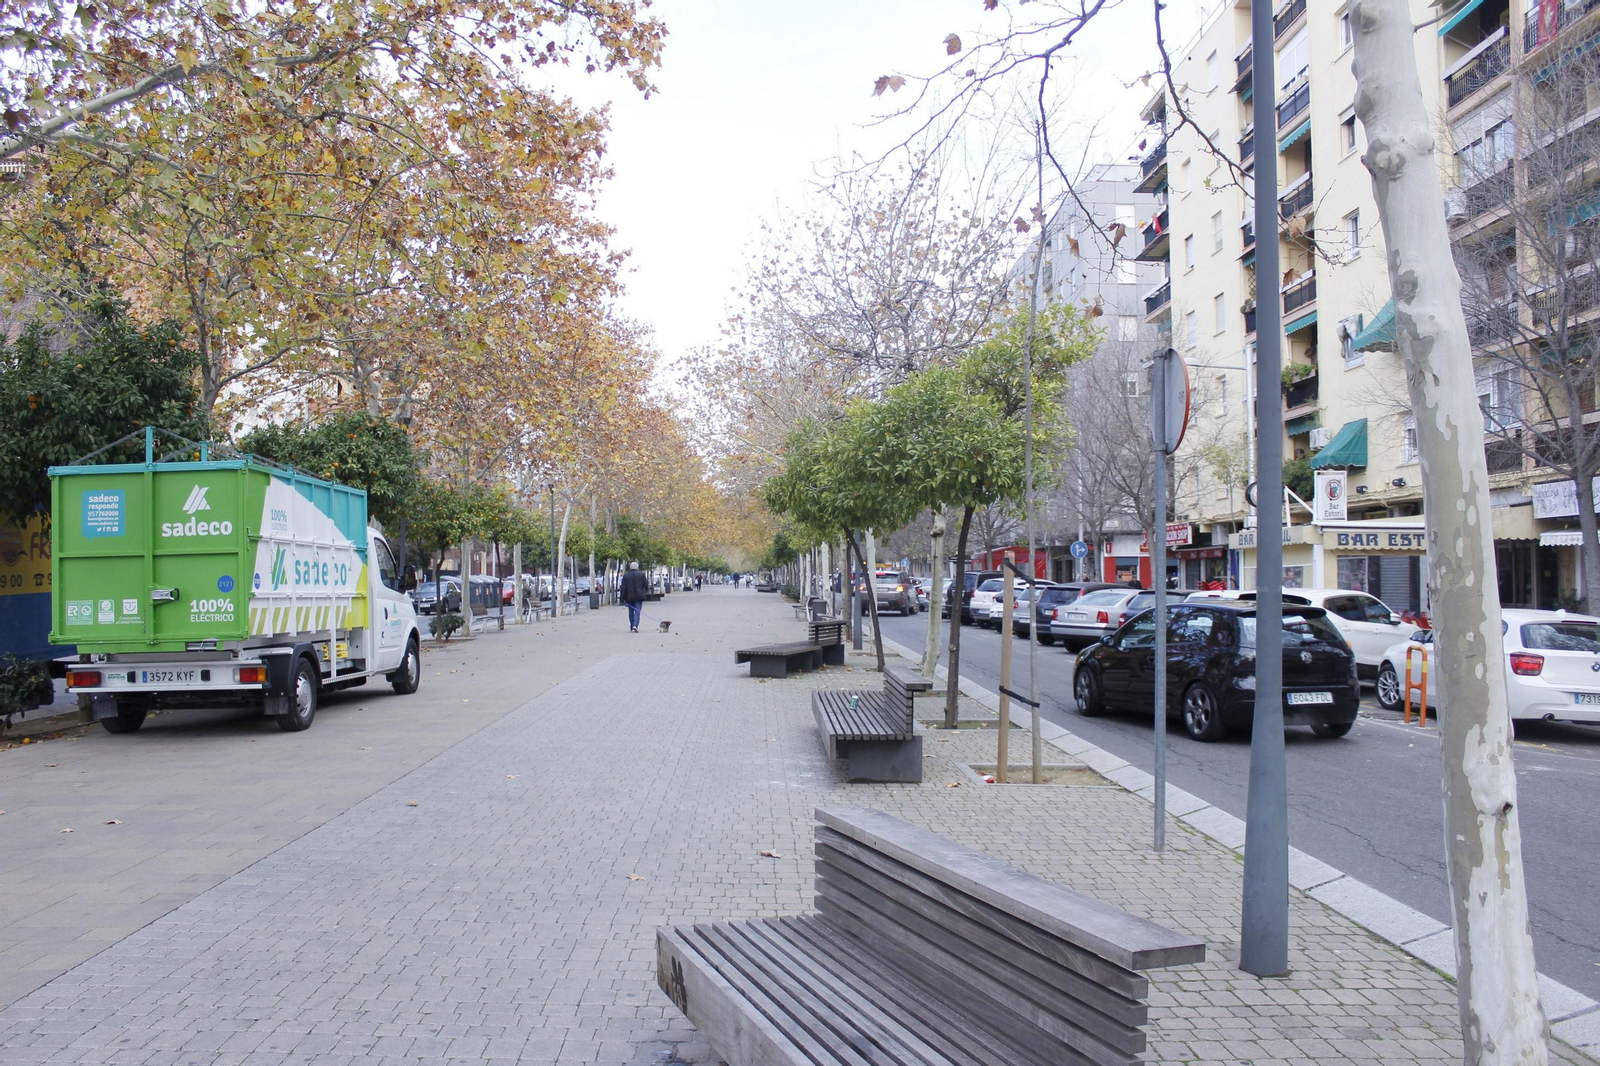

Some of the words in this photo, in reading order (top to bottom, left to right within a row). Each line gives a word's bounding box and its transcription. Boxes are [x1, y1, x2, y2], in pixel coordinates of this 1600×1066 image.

[88, 494, 119, 503] sadeco
[88, 503, 119, 511] responde
[271, 509, 287, 522] 100%
[1324, 510, 1345, 518] Estoril
[162, 516, 233, 537] sadeco
[1238, 533, 1255, 546] BAR
[1337, 533, 1379, 547] BAR
[1387, 533, 1425, 547] EST
[190, 598, 235, 613] 100%
[190, 612, 235, 622] ELÉCTRICO
[149, 671, 174, 682] 3572
[176, 670, 195, 681] KYF
[1293, 693, 1314, 703] 6043
[1315, 693, 1332, 702] FDL
